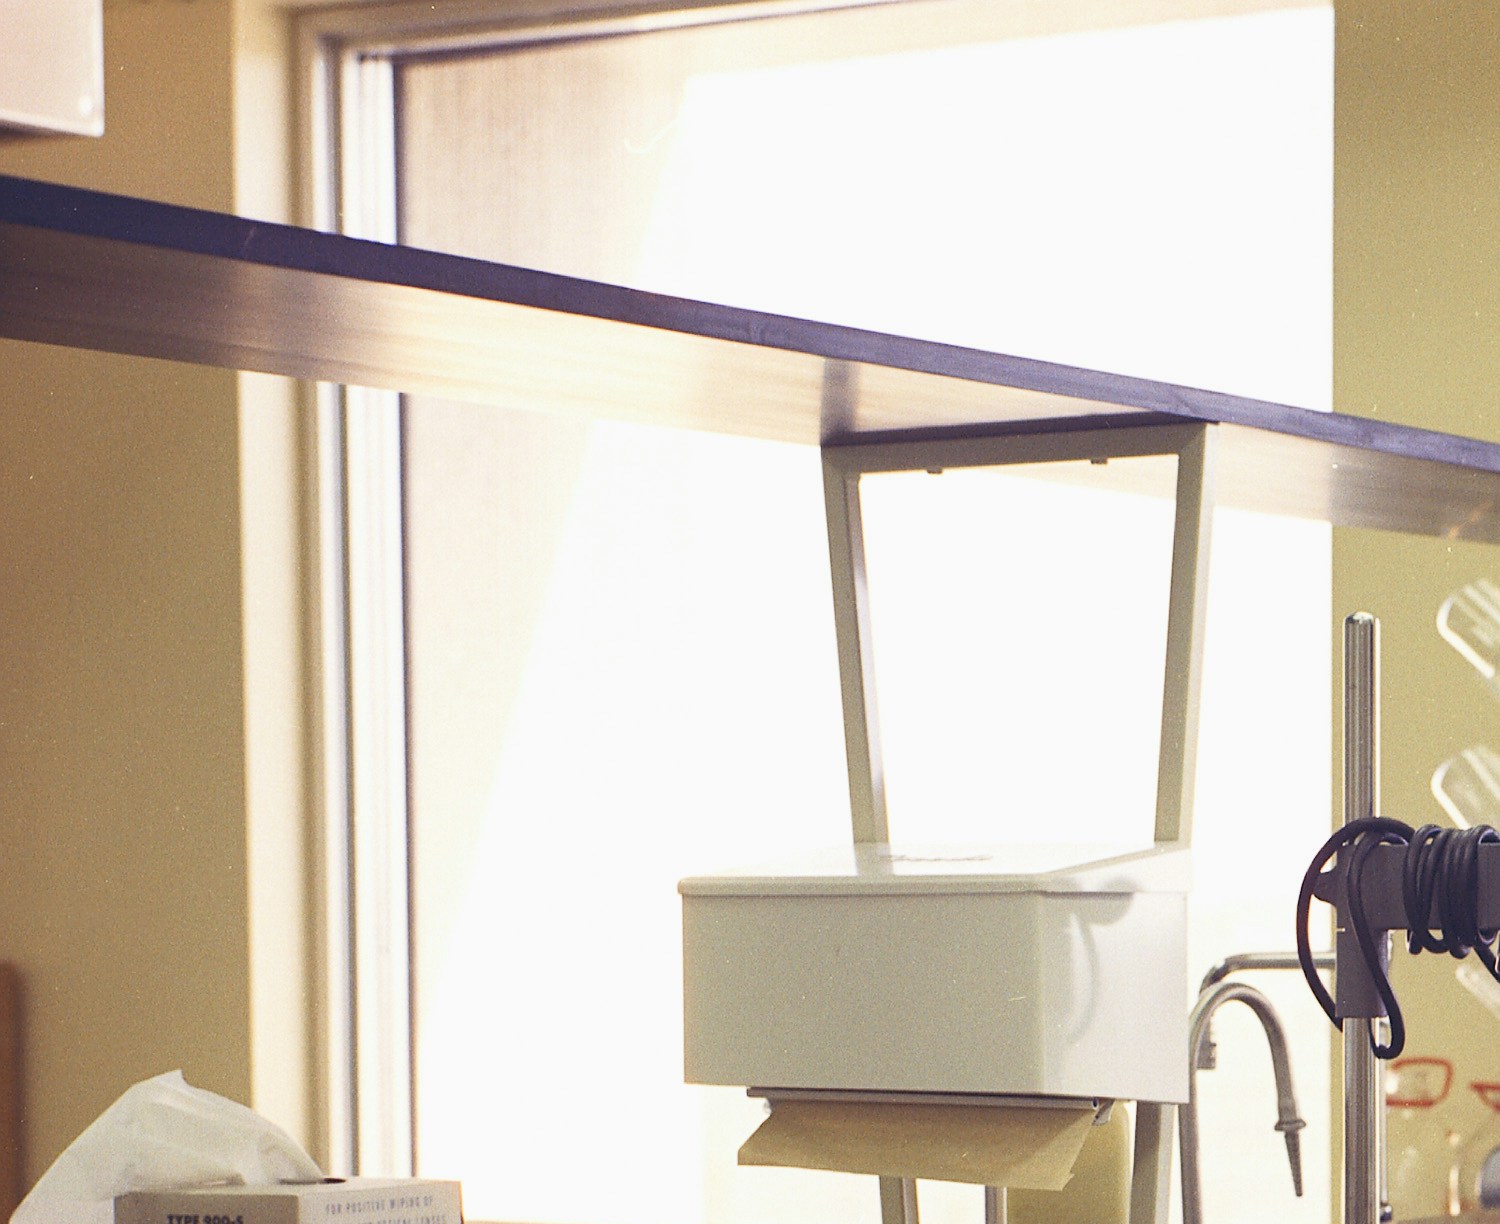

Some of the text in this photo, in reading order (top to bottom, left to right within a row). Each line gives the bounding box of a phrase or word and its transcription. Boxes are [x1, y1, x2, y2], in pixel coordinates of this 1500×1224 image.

[325, 1195, 434, 1215] FOR POSITIVE WIPING OF
